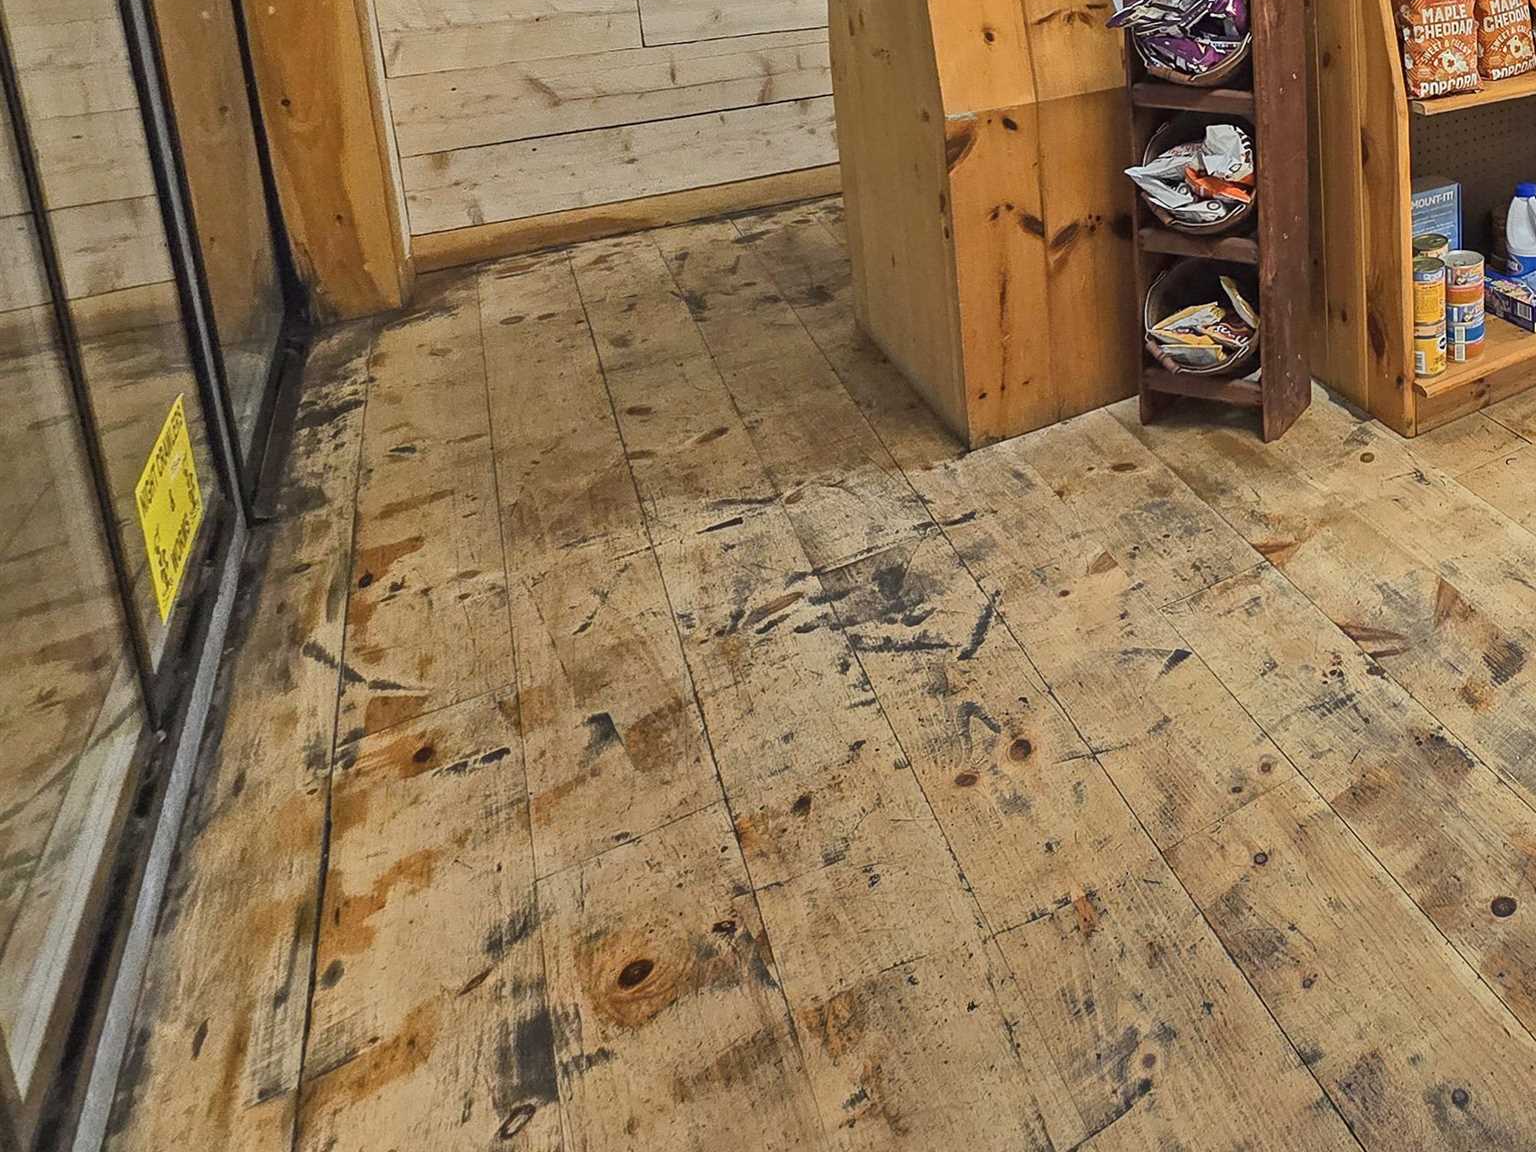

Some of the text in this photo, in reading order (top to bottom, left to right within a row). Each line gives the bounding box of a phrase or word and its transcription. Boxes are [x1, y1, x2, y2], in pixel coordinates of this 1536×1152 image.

[1422, 3, 1468, 24] MAPLE
[1413, 20, 1475, 43] CHEDDAR
[1420, 73, 1480, 98] POPCORN
